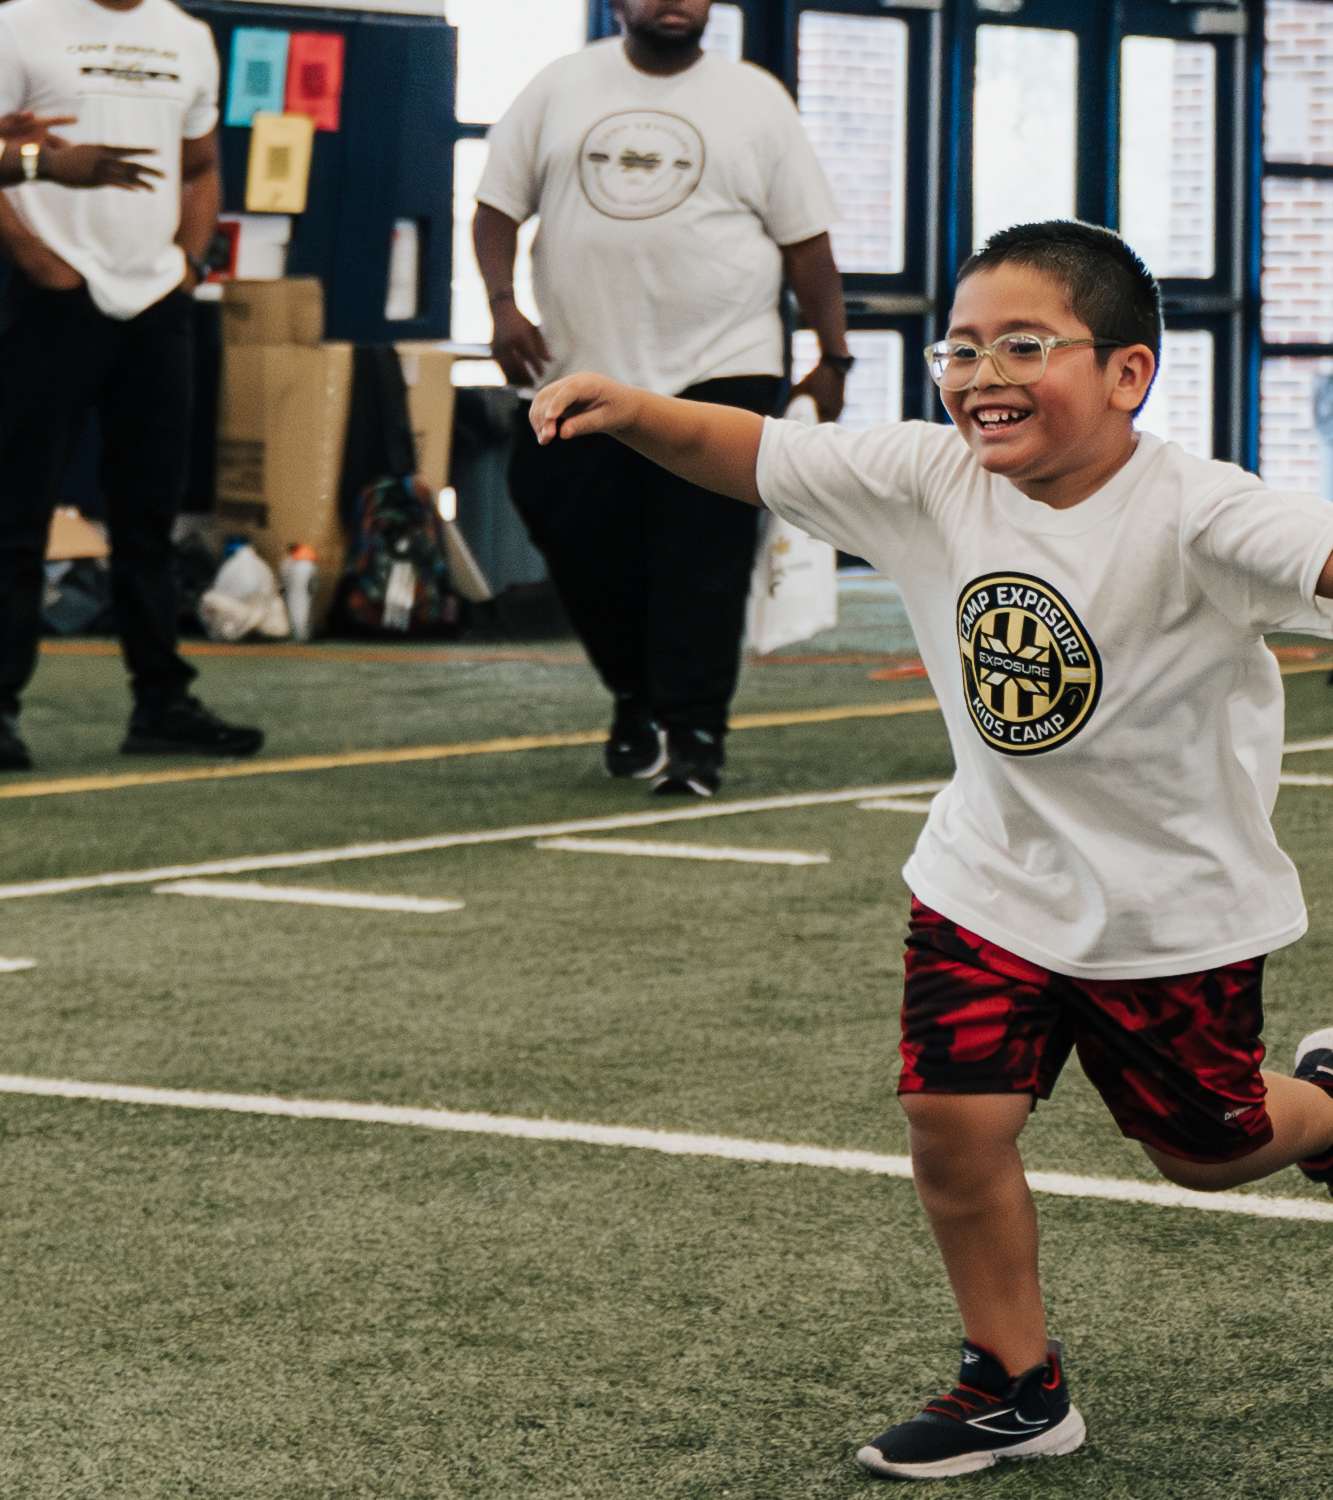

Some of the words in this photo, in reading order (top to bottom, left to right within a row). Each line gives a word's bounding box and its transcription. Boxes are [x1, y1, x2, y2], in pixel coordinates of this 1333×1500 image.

[961, 591, 990, 640] CAMP
[997, 586, 1086, 665] EXPOSURE
[979, 652, 1050, 678] EXPOSURE
[973, 697, 1004, 737] KIDS
[1010, 713, 1065, 742] CAMP
